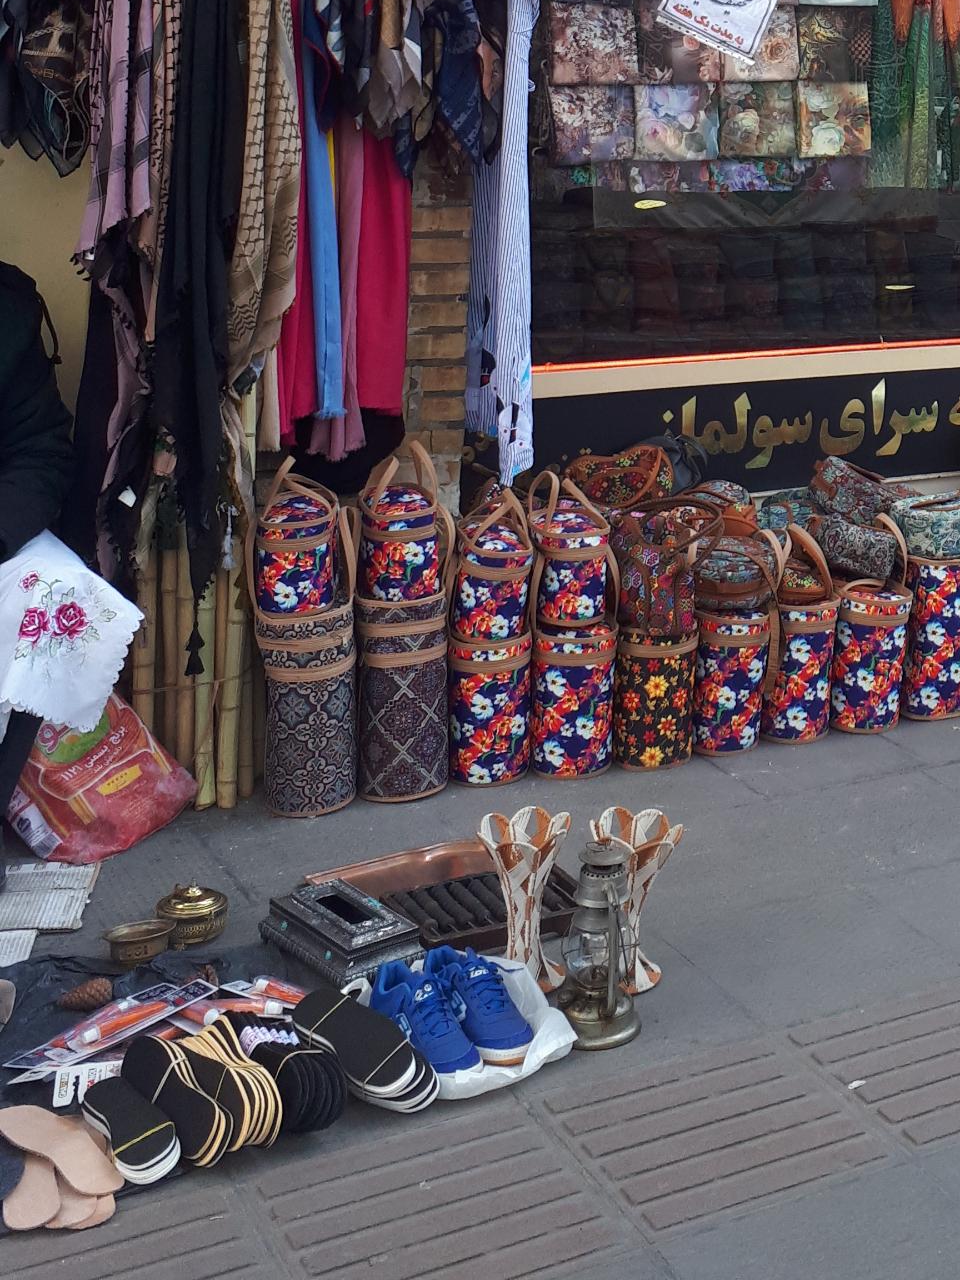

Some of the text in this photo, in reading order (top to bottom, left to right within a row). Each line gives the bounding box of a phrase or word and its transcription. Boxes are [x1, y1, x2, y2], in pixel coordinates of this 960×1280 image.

[672, 3, 693, 20] هفته
[693, 15, 710, 31] یک
[735, 35, 744, 49] به
[819, 377, 939, 456] سرای
